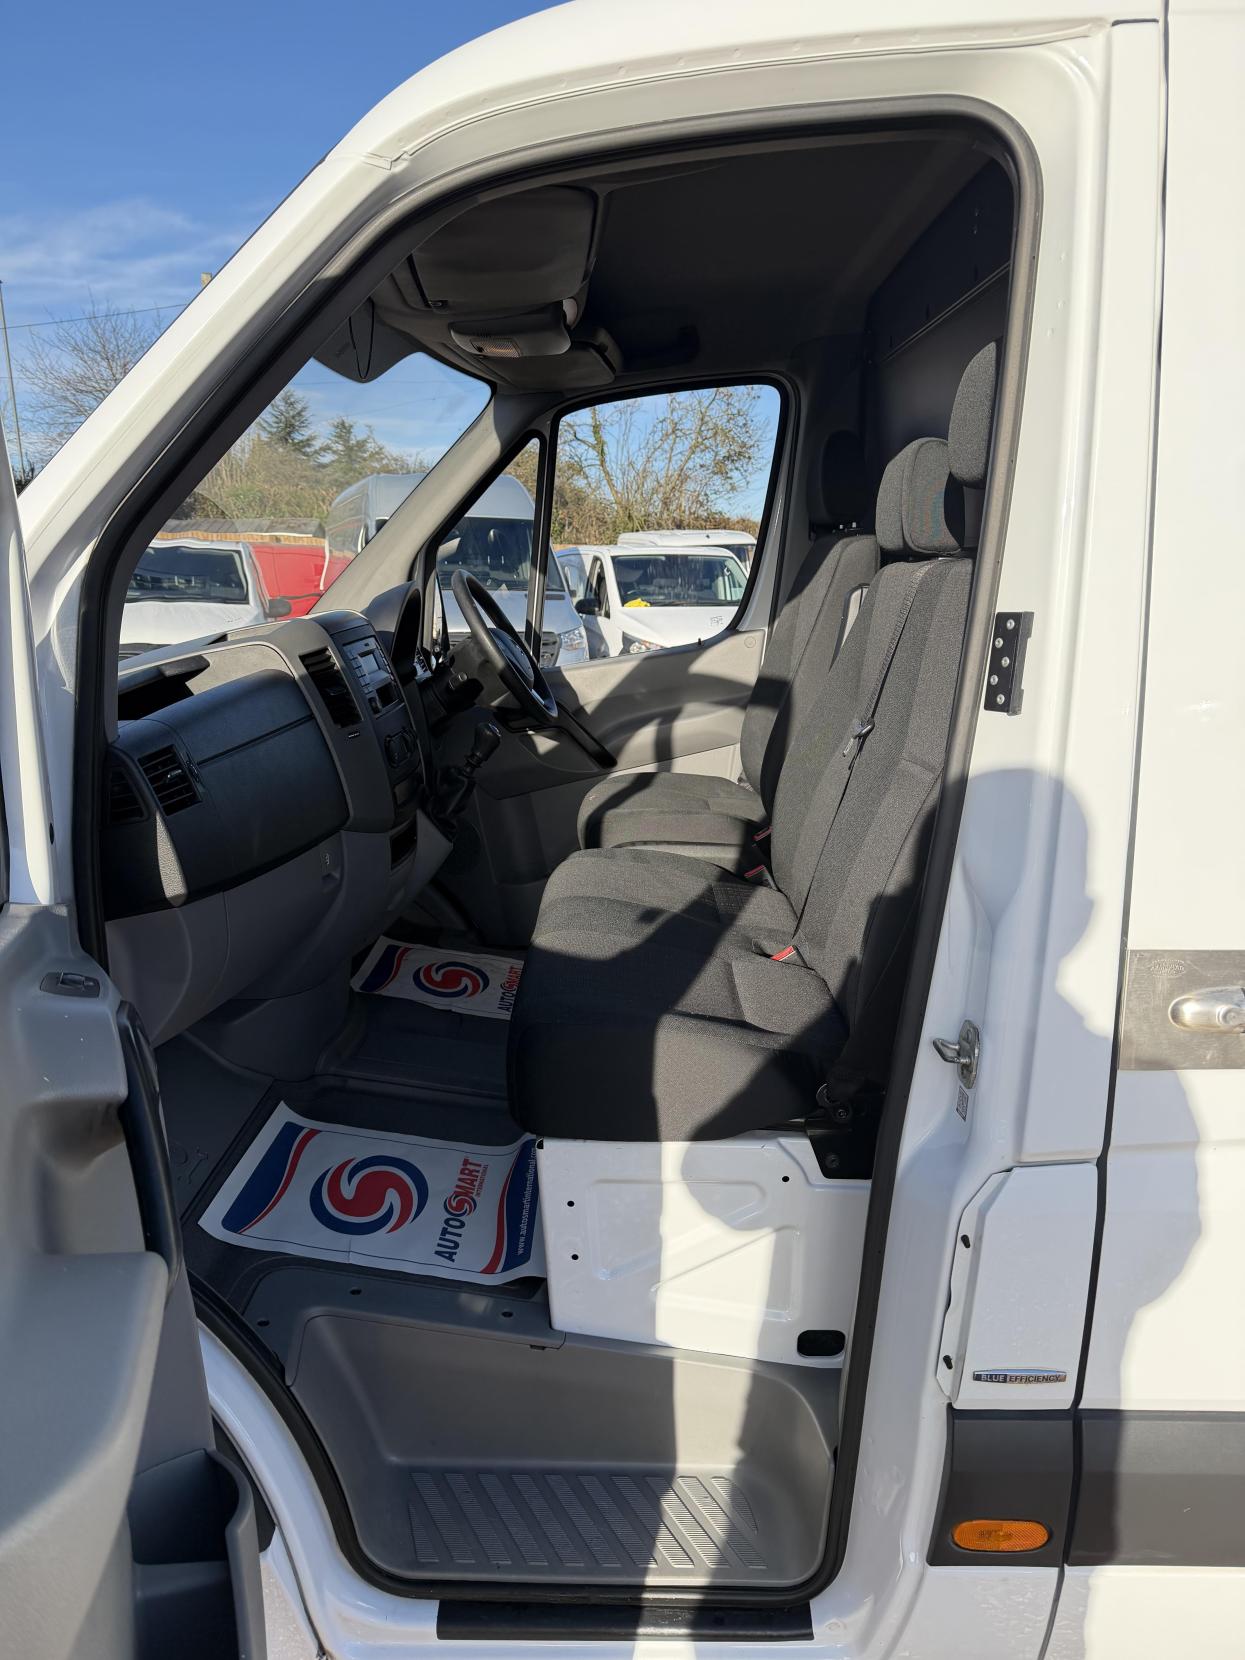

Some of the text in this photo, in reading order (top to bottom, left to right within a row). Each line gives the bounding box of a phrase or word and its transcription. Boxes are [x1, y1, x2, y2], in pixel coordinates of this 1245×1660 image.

[475, 1164, 489, 1198] INTERNATIONAL
[434, 1158, 482, 1263] AUTOSMART
[981, 1374, 1060, 1384] BLUE EFFICIENCY
